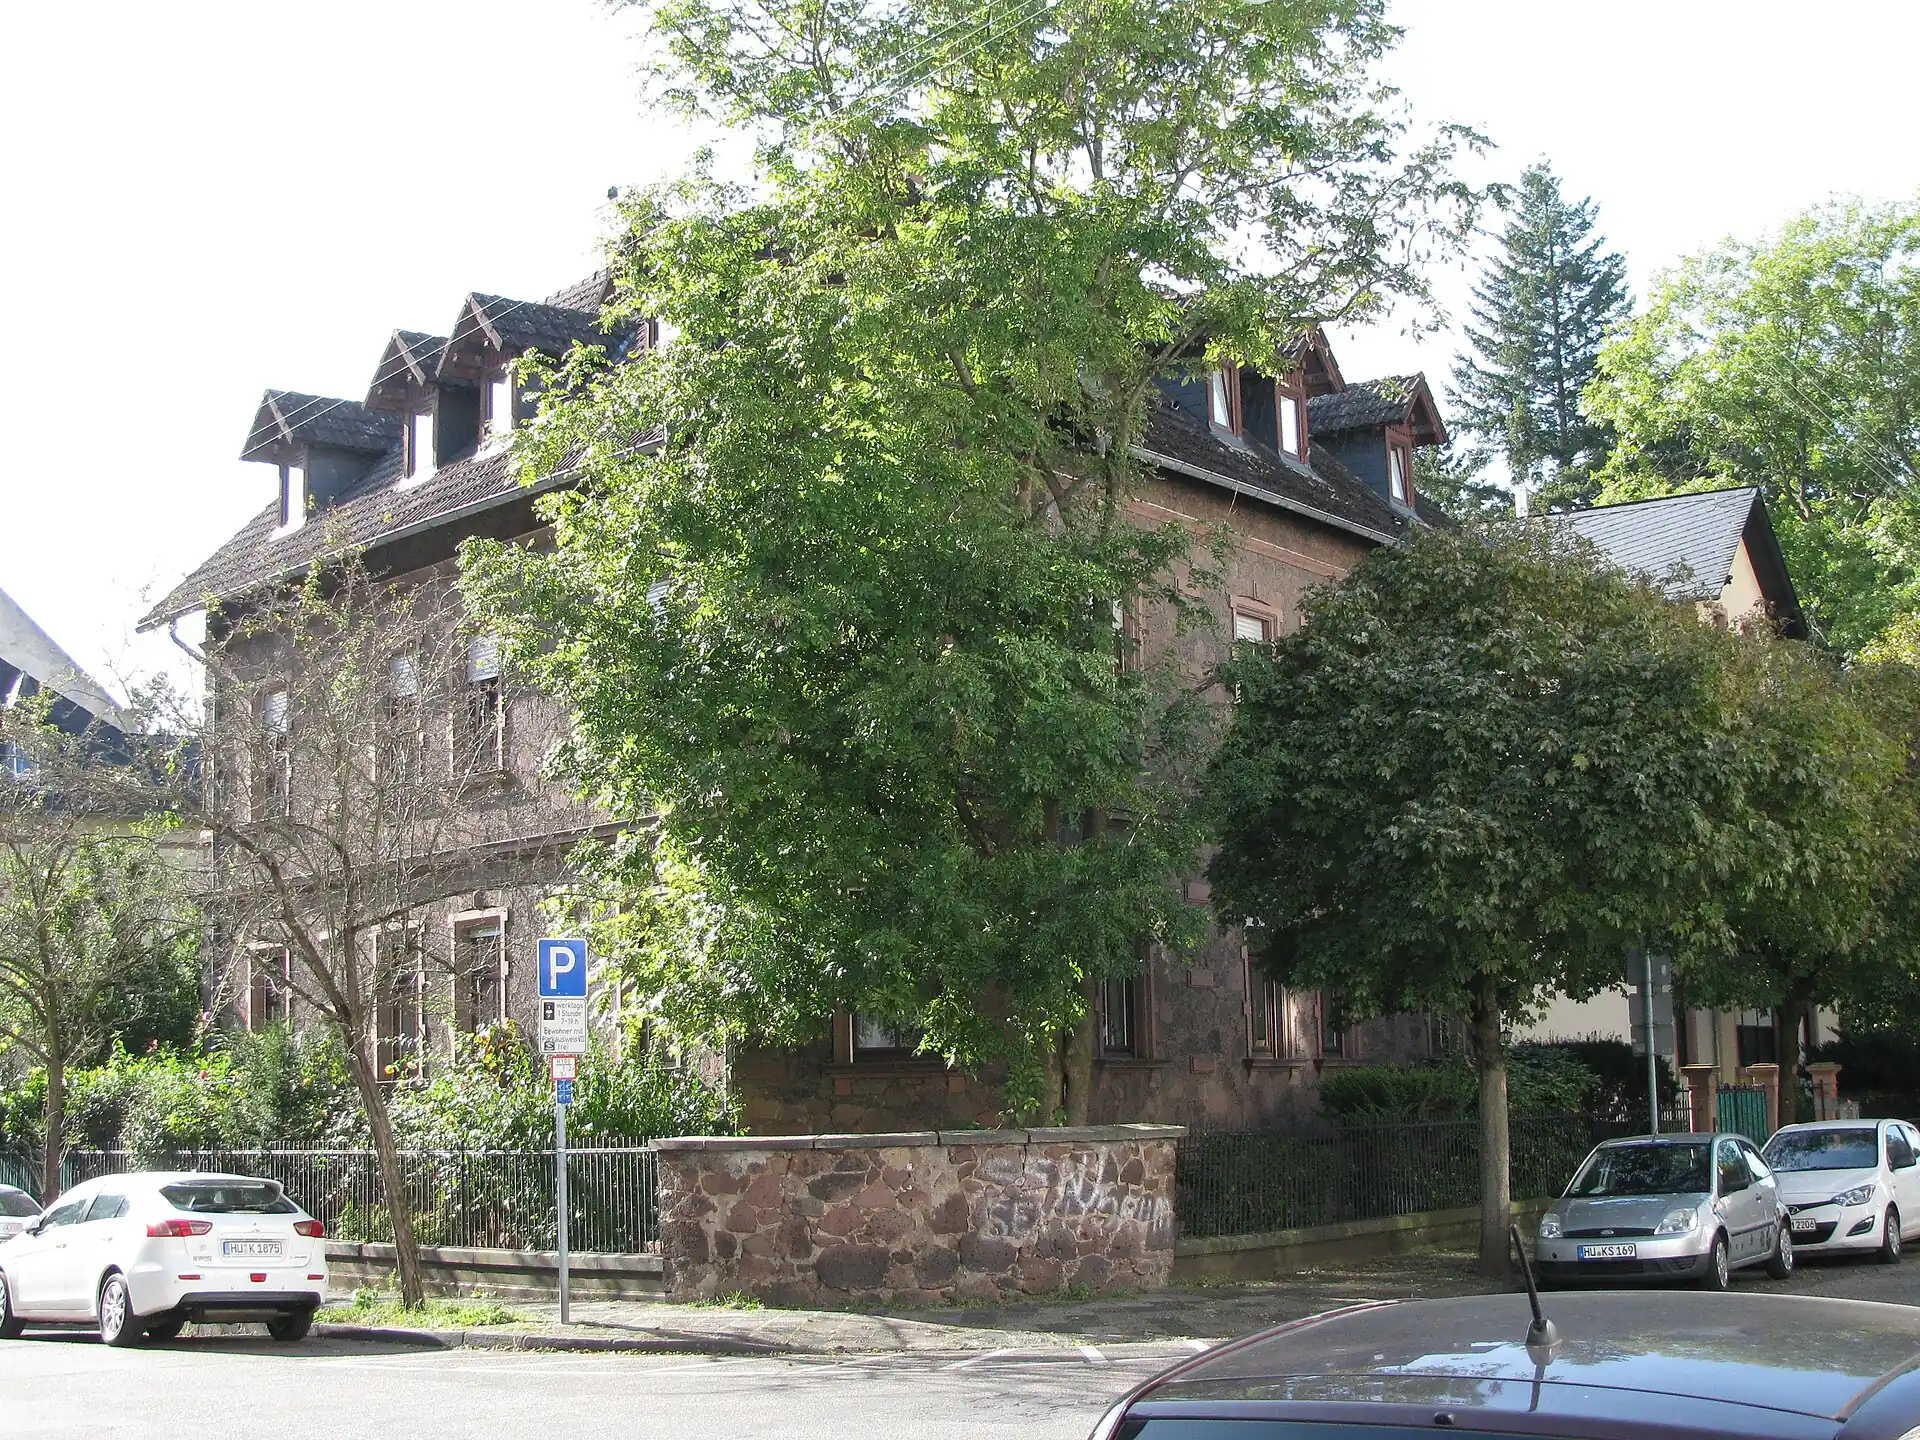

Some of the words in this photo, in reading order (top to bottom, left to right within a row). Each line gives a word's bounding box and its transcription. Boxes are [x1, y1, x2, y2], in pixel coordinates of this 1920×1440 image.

[550, 946, 576, 989] P
[556, 1002, 583, 1010] werktags
[230, 1243, 244, 1253] HU
[249, 1243, 255, 1253] K
[257, 1243, 280, 1253] 1875
[1584, 1247, 1596, 1256] HU
[1601, 1246, 1614, 1256] KS
[1616, 1245, 1633, 1255] 169
